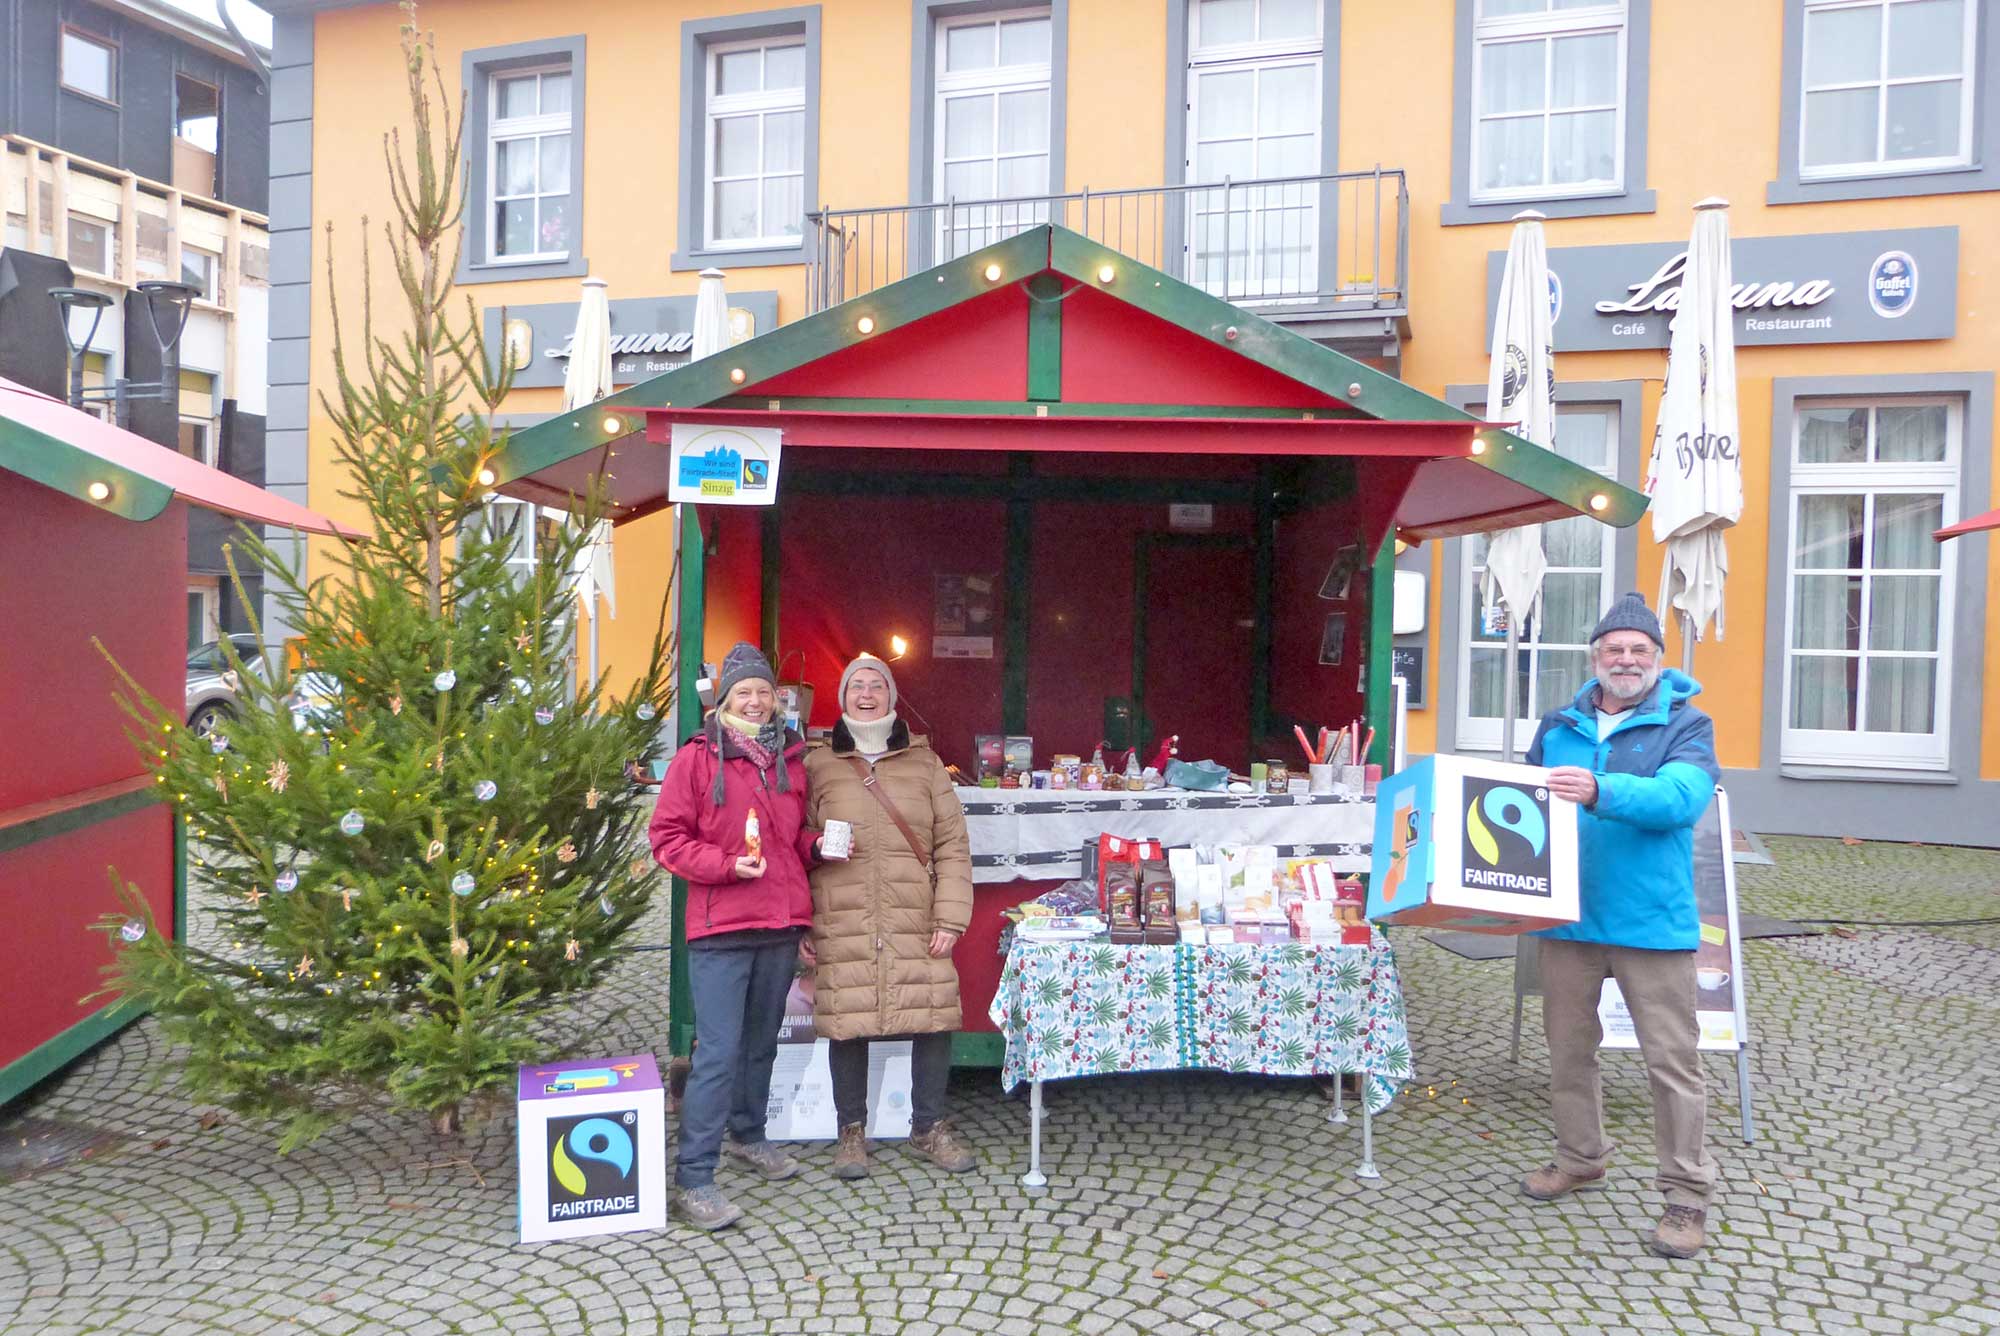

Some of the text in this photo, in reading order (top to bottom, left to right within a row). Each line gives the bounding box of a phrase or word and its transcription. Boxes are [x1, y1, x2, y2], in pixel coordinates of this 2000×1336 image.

[1595, 251, 1835, 331] Launa
[1876, 276, 1911, 289] Gaffel
[1612, 316, 1832, 336] Café Restaurant
[618, 362, 637, 372] Bar
[702, 482, 733, 495] Sinzig
[1464, 868, 1548, 892] FAIRTRADE
[552, 1195, 636, 1217] FAIRTRADE
